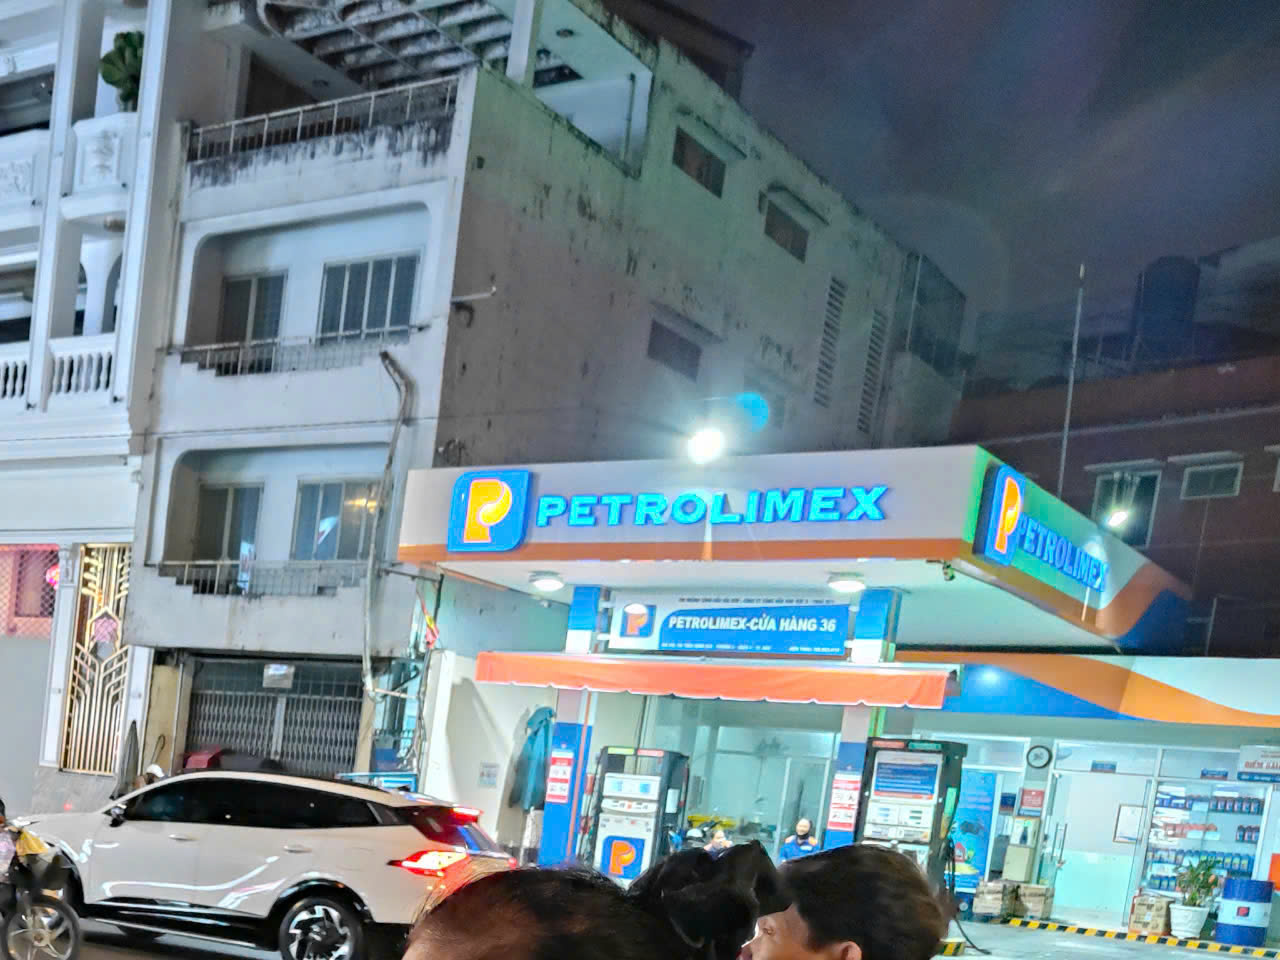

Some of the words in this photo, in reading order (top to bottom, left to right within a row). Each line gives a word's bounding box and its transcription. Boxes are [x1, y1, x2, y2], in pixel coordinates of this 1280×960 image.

[535, 484, 890, 528] PETROLIMEX
[1018, 512, 1109, 592] PETROLIMEX
[779, 614, 817, 632] HÀNG
[820, 617, 837, 632] 36
